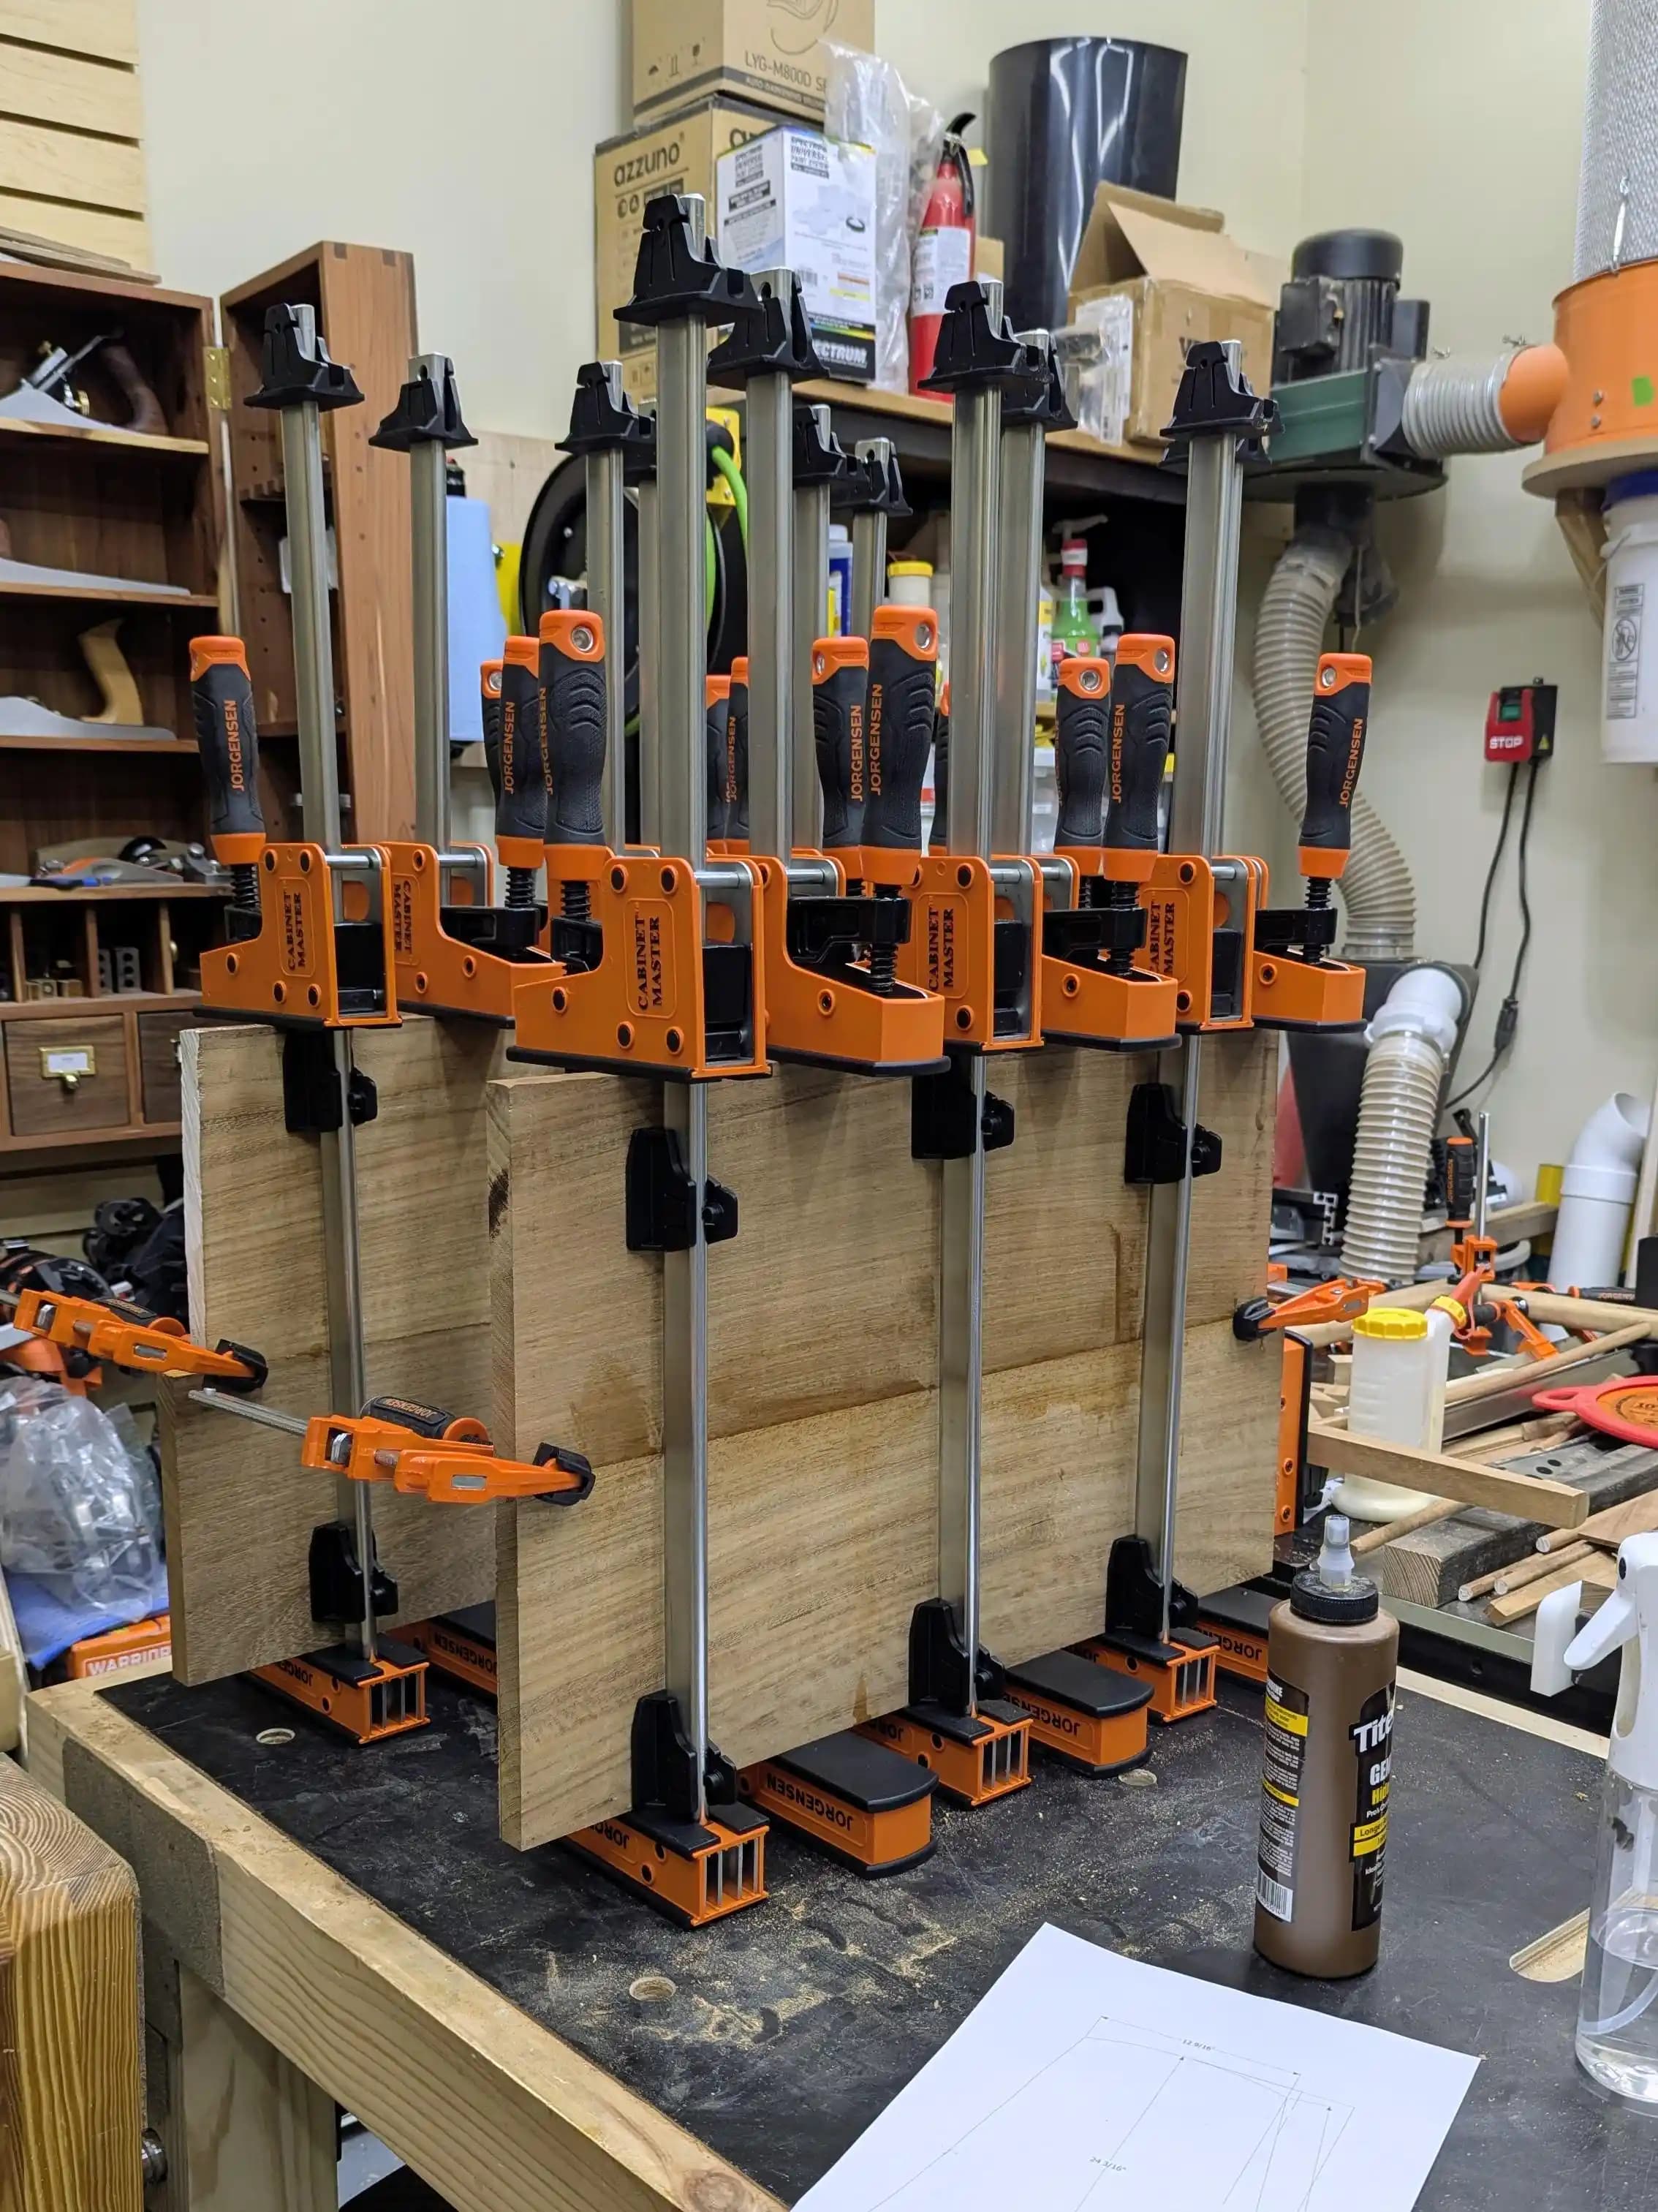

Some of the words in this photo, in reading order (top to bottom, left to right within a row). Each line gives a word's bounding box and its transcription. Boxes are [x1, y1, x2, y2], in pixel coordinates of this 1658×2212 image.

[744, 50, 812, 88] LYG-M800D
[613, 142, 681, 188] azzuno
[224, 700, 244, 793] JORGENSEN
[503, 701, 515, 796] JORGENSEN
[850, 705, 863, 802] JORGENSEN
[870, 684, 883, 796] JORGENSEN
[1111, 703, 1126, 804] JORGENSEN
[1339, 717, 1363, 808] JORGENSEN
[1489, 736, 1523, 750] STOP
[284, 891, 296, 971] CABINET
[294, 892, 306, 968] MASTER
[403, 880, 412, 954] CABINET
[928, 907, 939, 991] CABINET
[943, 907, 954, 989] MASTER
[1163, 902, 1175, 976] MASTER
[635, 915, 648, 1011] CABINET
[649, 916, 662, 1007] MASTER
[385, 1398, 439, 1418] JORGENSEN
[766, 1773, 855, 1831] JORGENSEN
[1371, 1783, 1390, 1805] Hid
